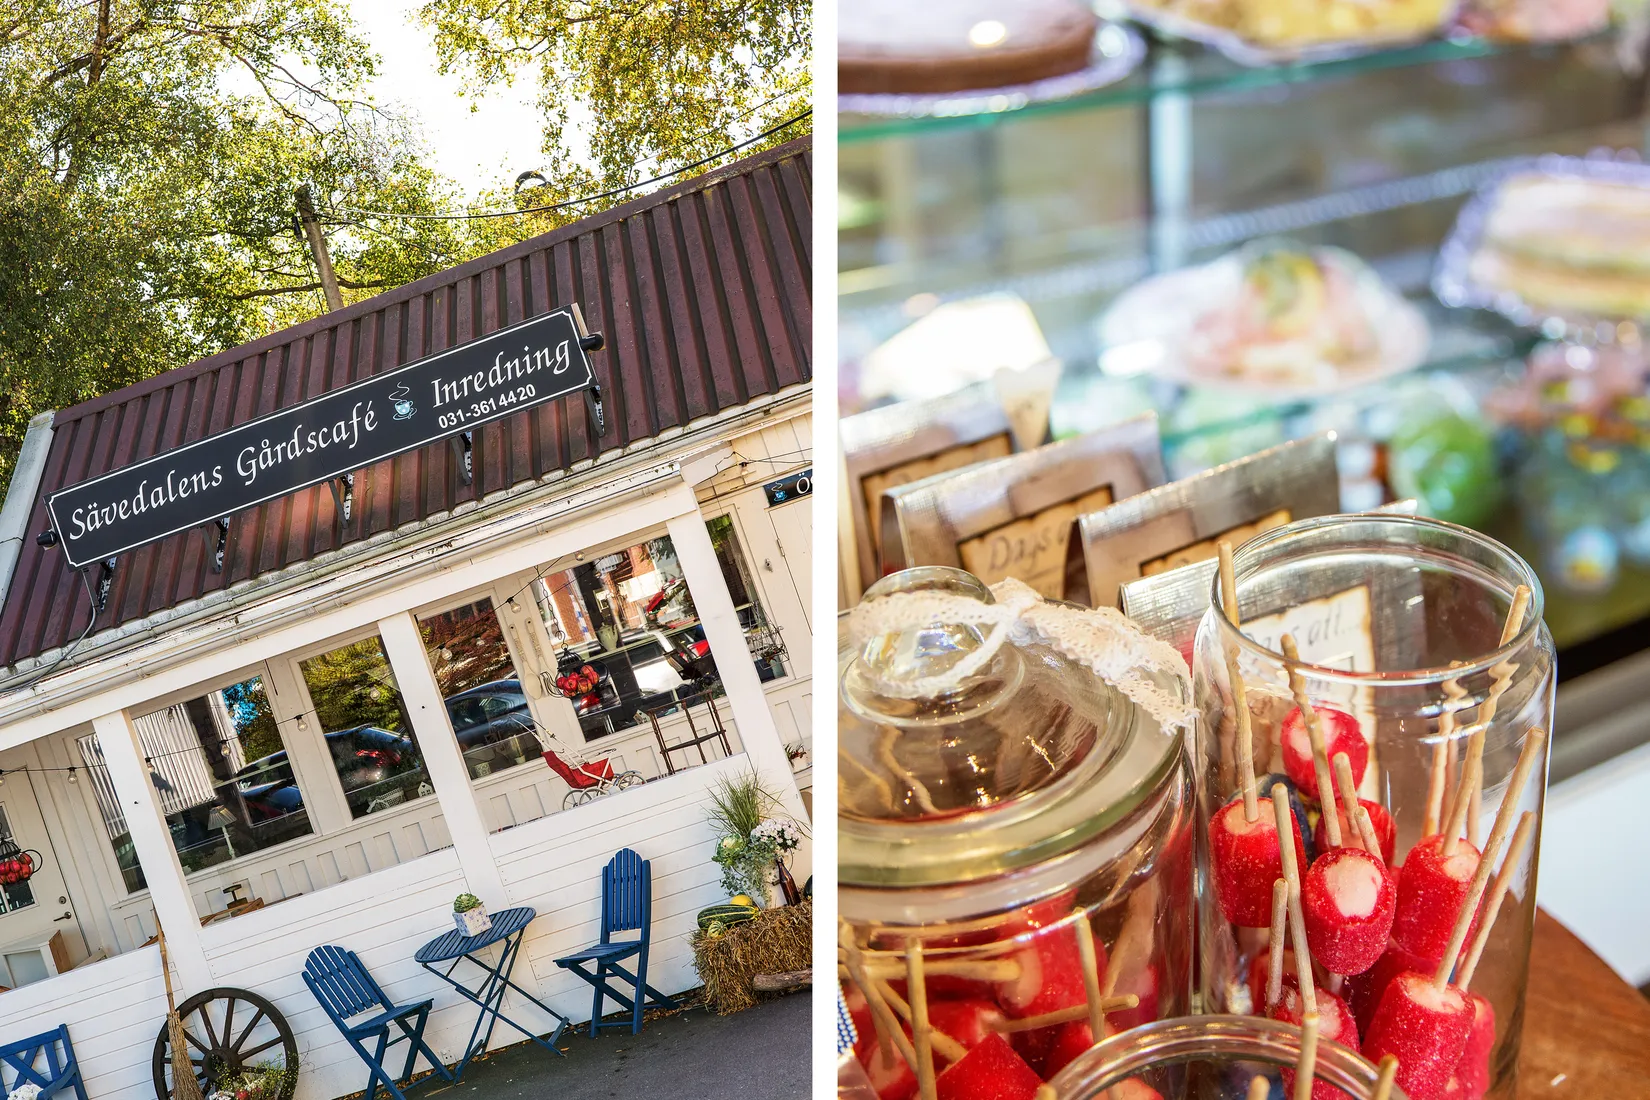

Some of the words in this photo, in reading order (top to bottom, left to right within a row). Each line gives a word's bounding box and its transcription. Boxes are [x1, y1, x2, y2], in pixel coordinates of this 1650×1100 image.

[69, 465, 223, 541] Sävedalens
[236, 400, 378, 486] Gårdscafé
[431, 339, 570, 408] Inredning
